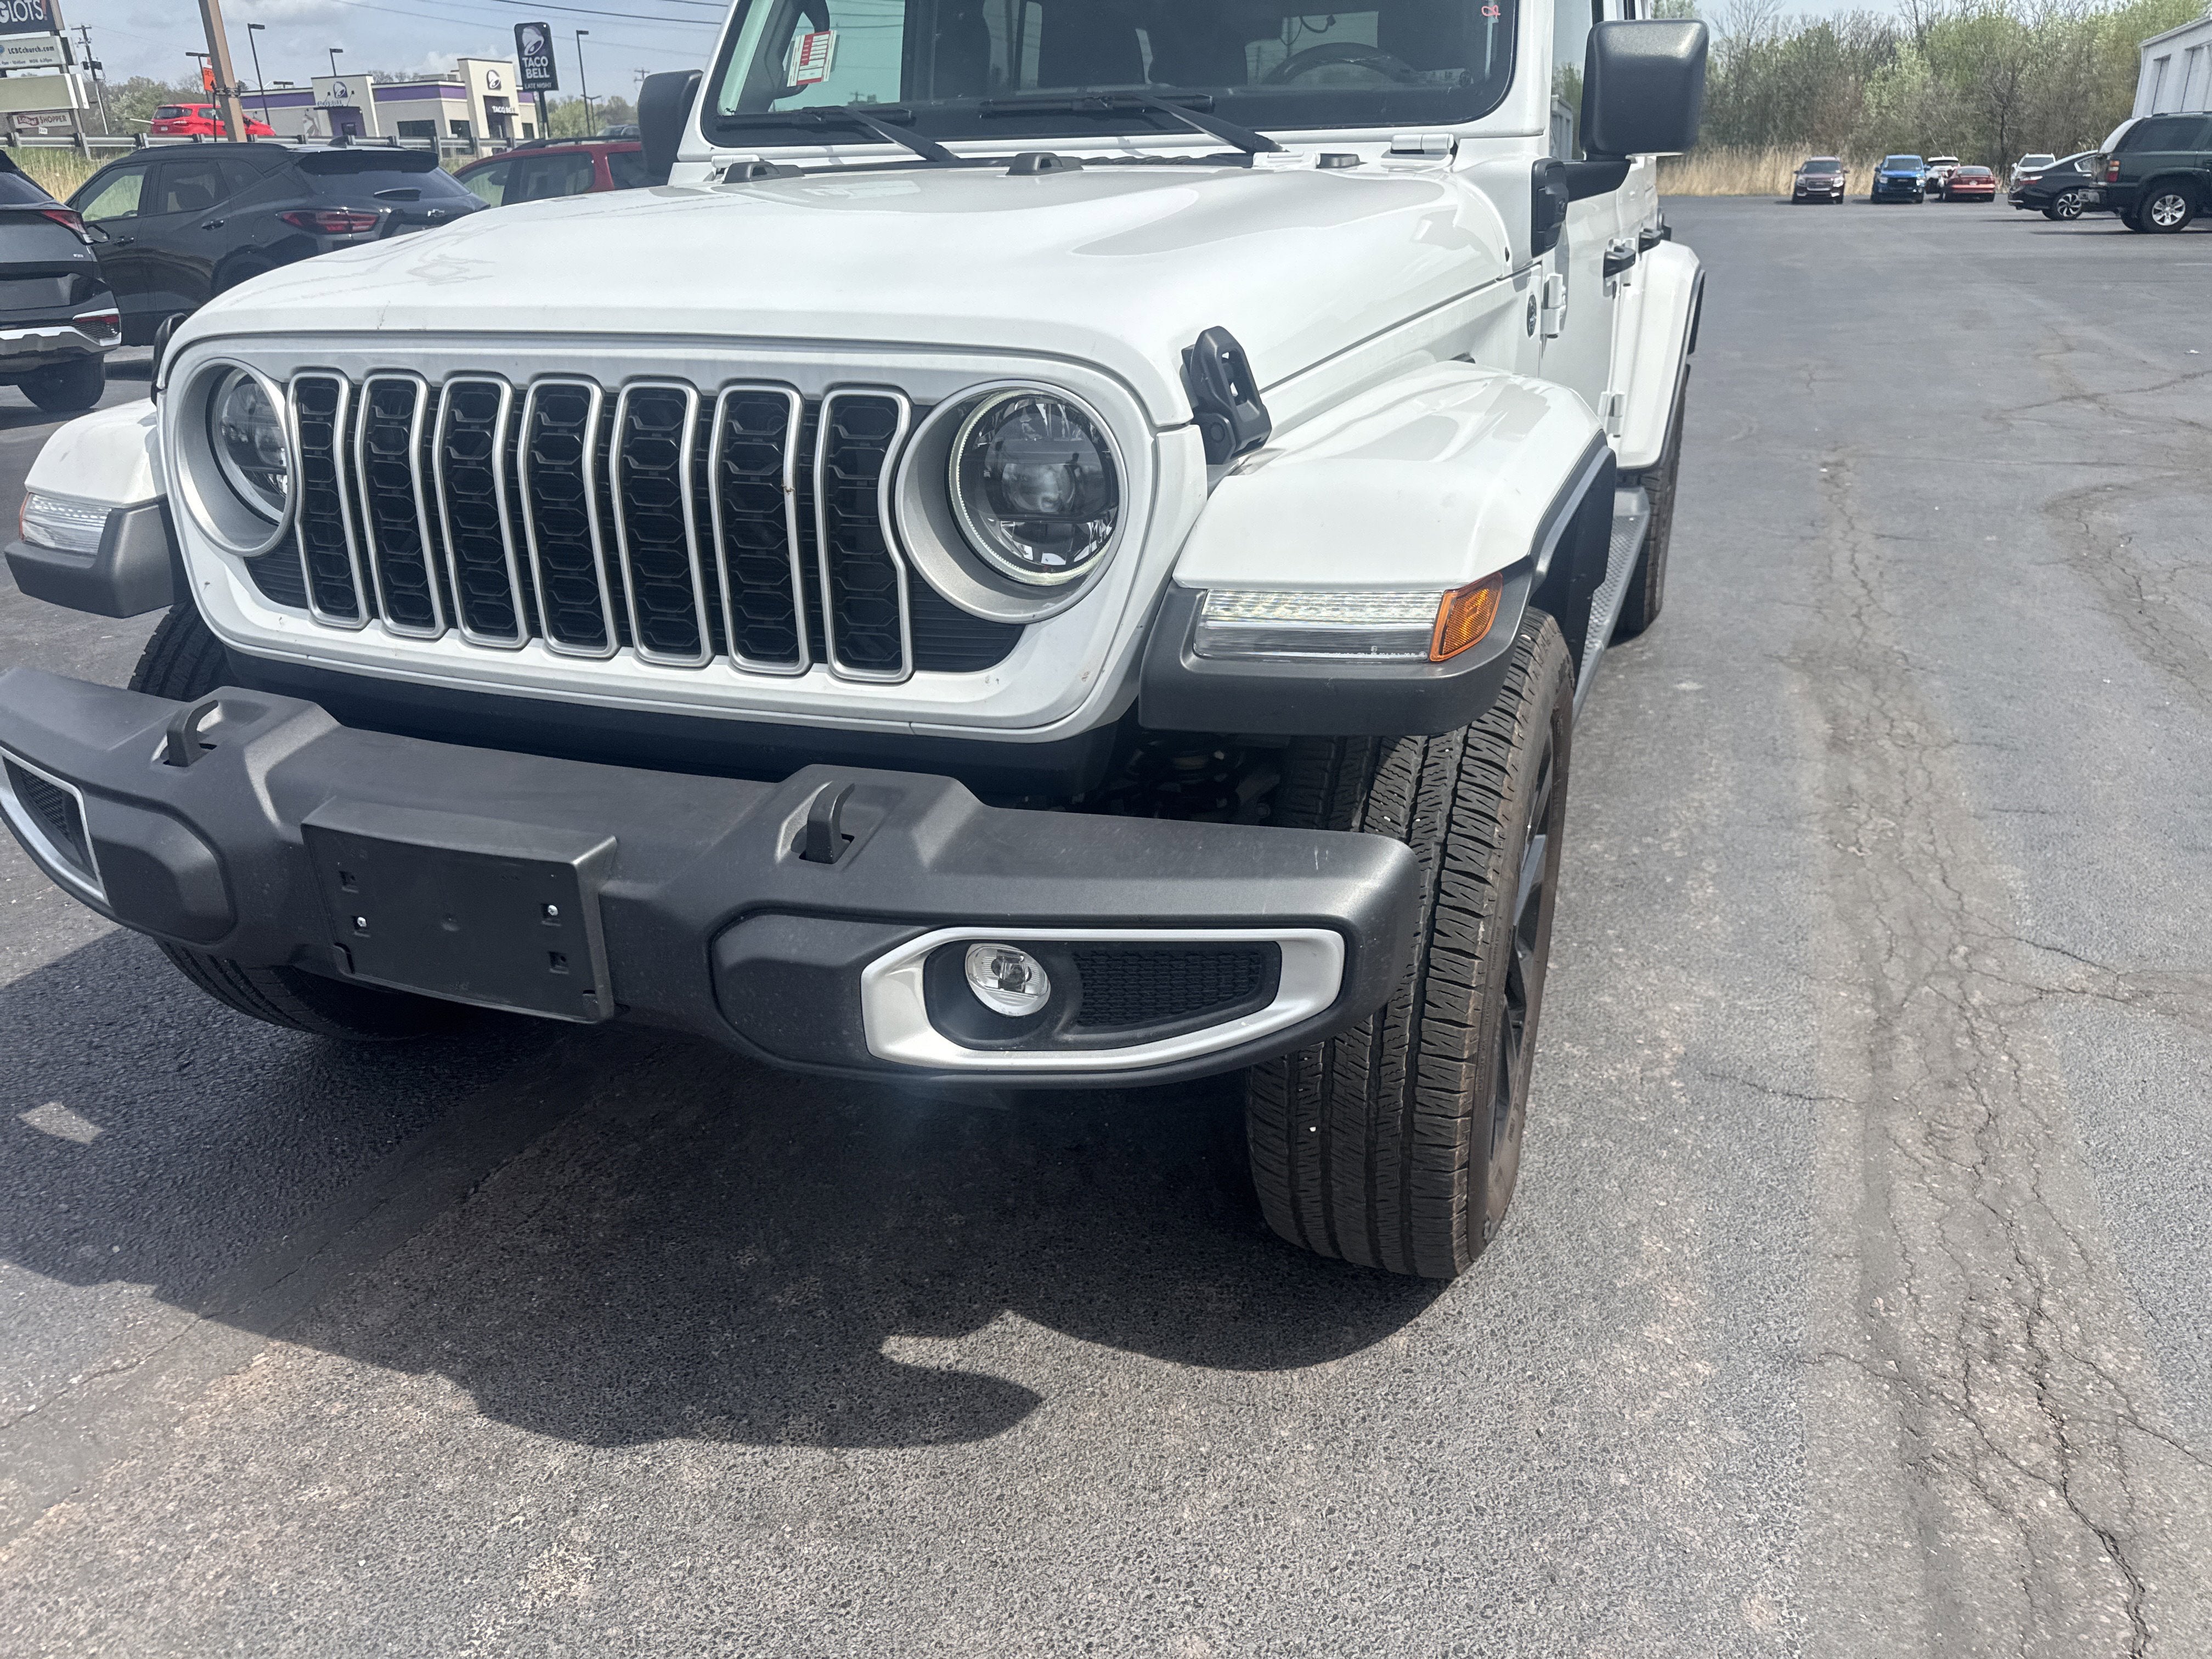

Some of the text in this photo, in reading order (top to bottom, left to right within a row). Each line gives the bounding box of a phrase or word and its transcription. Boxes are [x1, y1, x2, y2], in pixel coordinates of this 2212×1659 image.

[522, 56, 549, 67] TACO
[526, 67, 550, 79] BELL
[492, 105, 505, 114] TACO
[39, 115, 67, 124] SHOPPER
